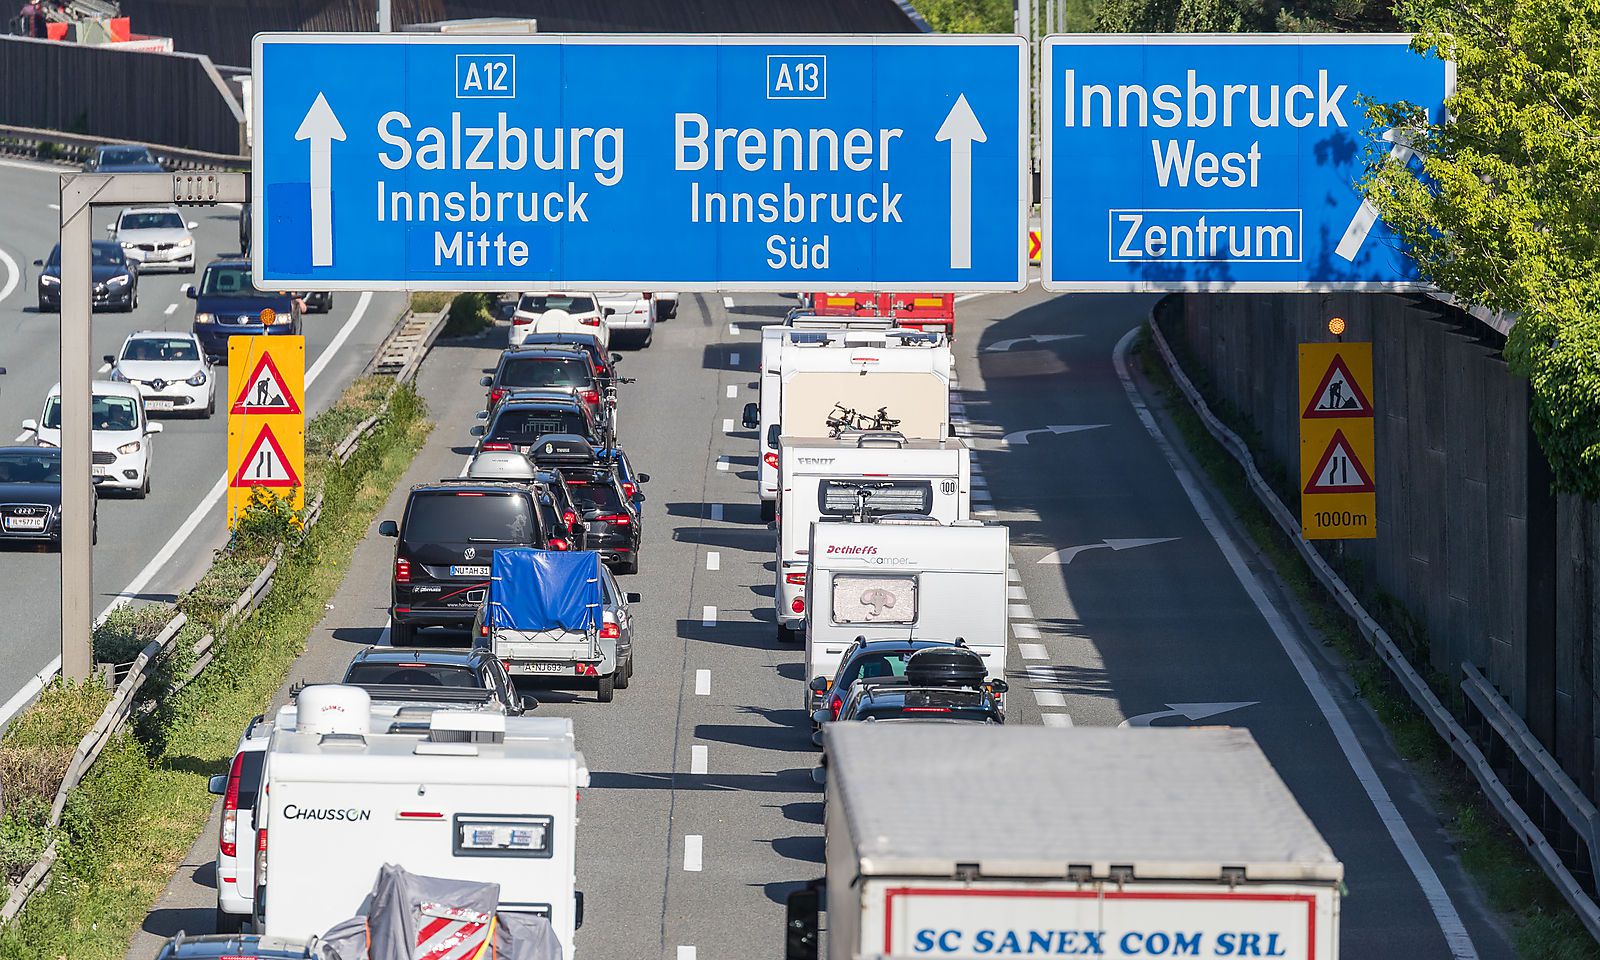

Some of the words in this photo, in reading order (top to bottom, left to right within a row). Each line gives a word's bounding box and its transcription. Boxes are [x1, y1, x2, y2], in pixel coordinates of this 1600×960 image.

[463, 62, 508, 91] A12
[774, 62, 819, 92] A13
[1065, 69, 1348, 128] Innsbruck
[377, 110, 624, 187] Salzburg
[674, 112, 904, 172] Brenner
[1151, 139, 1261, 188] West
[377, 180, 589, 223] Innsbruck
[691, 182, 903, 223] Innsbruck
[434, 231, 529, 267] Mitte
[766, 234, 829, 270] Süd
[1118, 214, 1293, 258] Zentrum
[798, 457, 836, 465] FENDT
[942, 481, 955, 495] 100
[1314, 511, 1367, 527] 1000m
[827, 545, 878, 554] Dethleffs
[870, 556, 909, 566] camper
[283, 804, 371, 822] CHAUSSON
[913, 929, 961, 952] SC
[972, 930, 1105, 954] SANEX
[1120, 932, 1203, 955] COM
[1214, 933, 1286, 957] SRL
